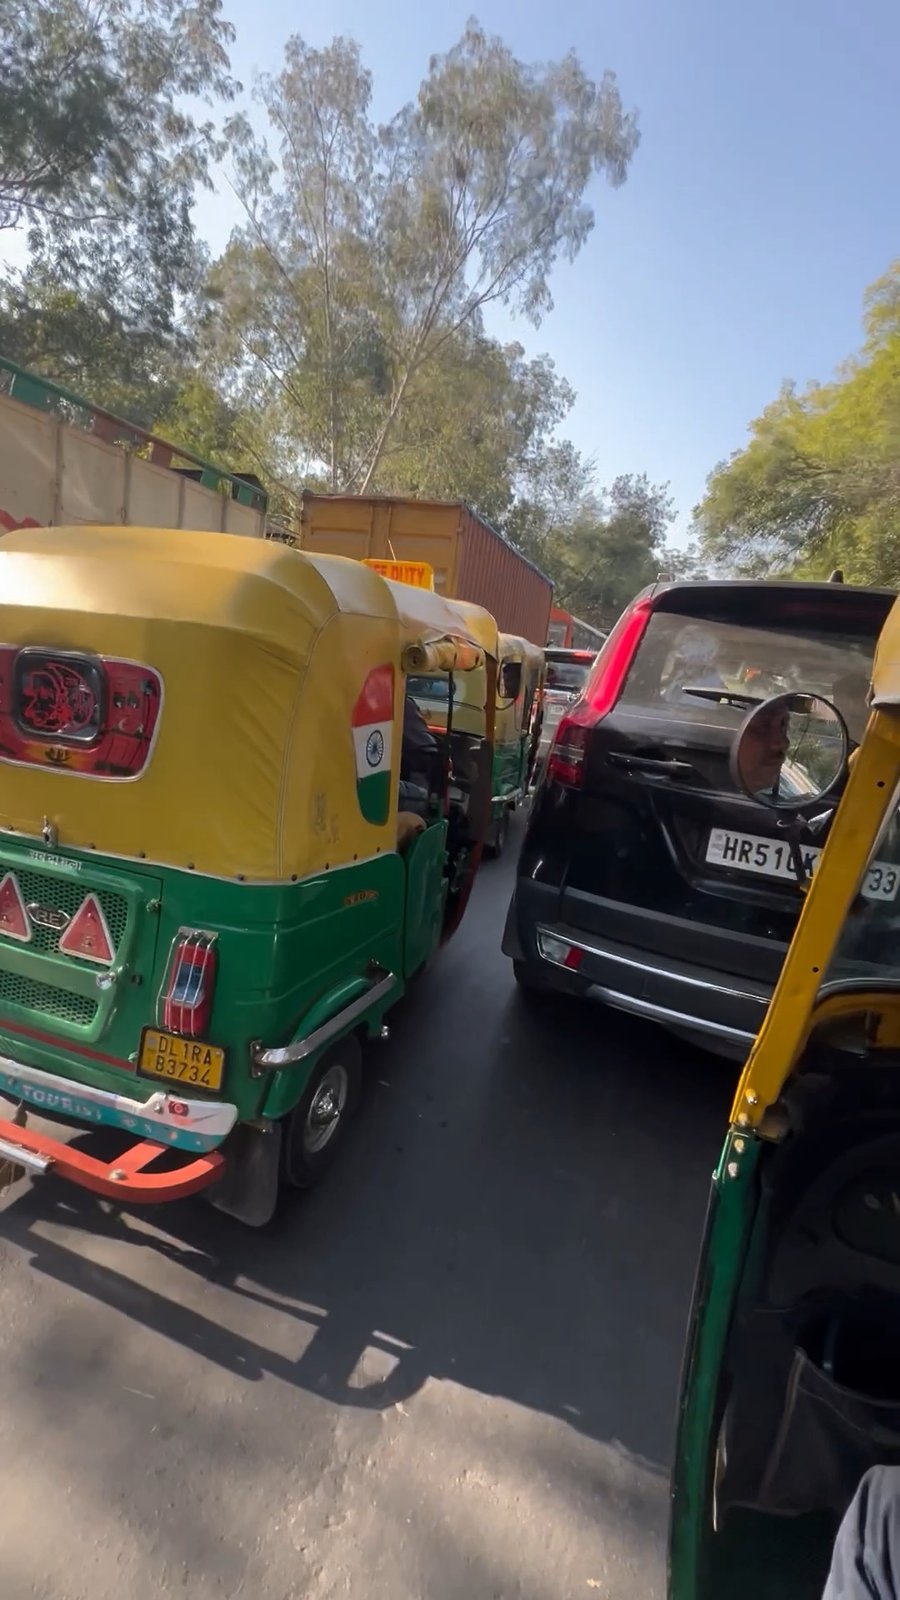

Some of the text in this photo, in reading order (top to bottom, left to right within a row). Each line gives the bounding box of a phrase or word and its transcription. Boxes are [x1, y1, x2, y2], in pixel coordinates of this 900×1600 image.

[391, 565, 425, 586] DUTY
[158, 1035, 211, 1066] DL1RA
[155, 1054, 210, 1086] B3734
